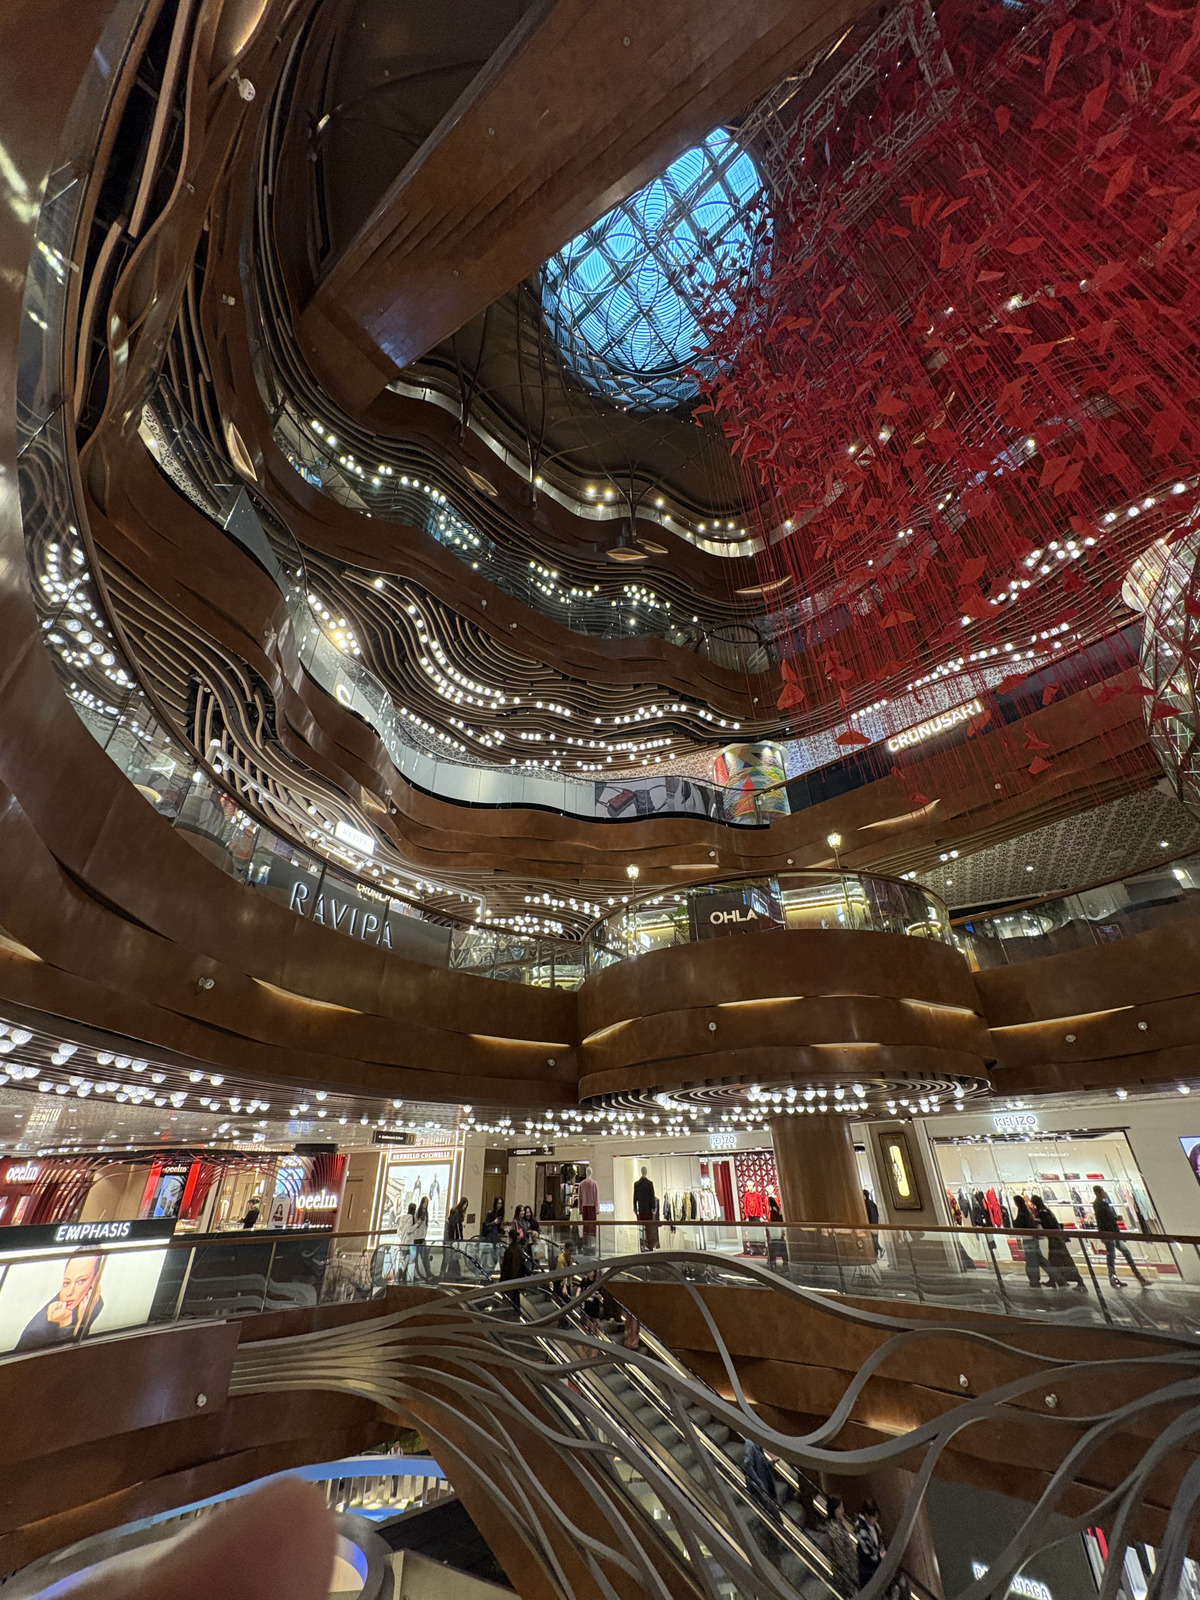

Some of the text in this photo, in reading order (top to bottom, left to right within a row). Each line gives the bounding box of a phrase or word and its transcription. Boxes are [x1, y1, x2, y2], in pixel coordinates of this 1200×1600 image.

[289, 881, 393, 949] RAVIPA
[709, 909, 758, 925] OHLA
[993, 1114, 1037, 1128] KENZO
[392, 1151, 451, 1160] BRUNELLO CUCINELLI
[56, 1221, 131, 1242] EMPHASIS
